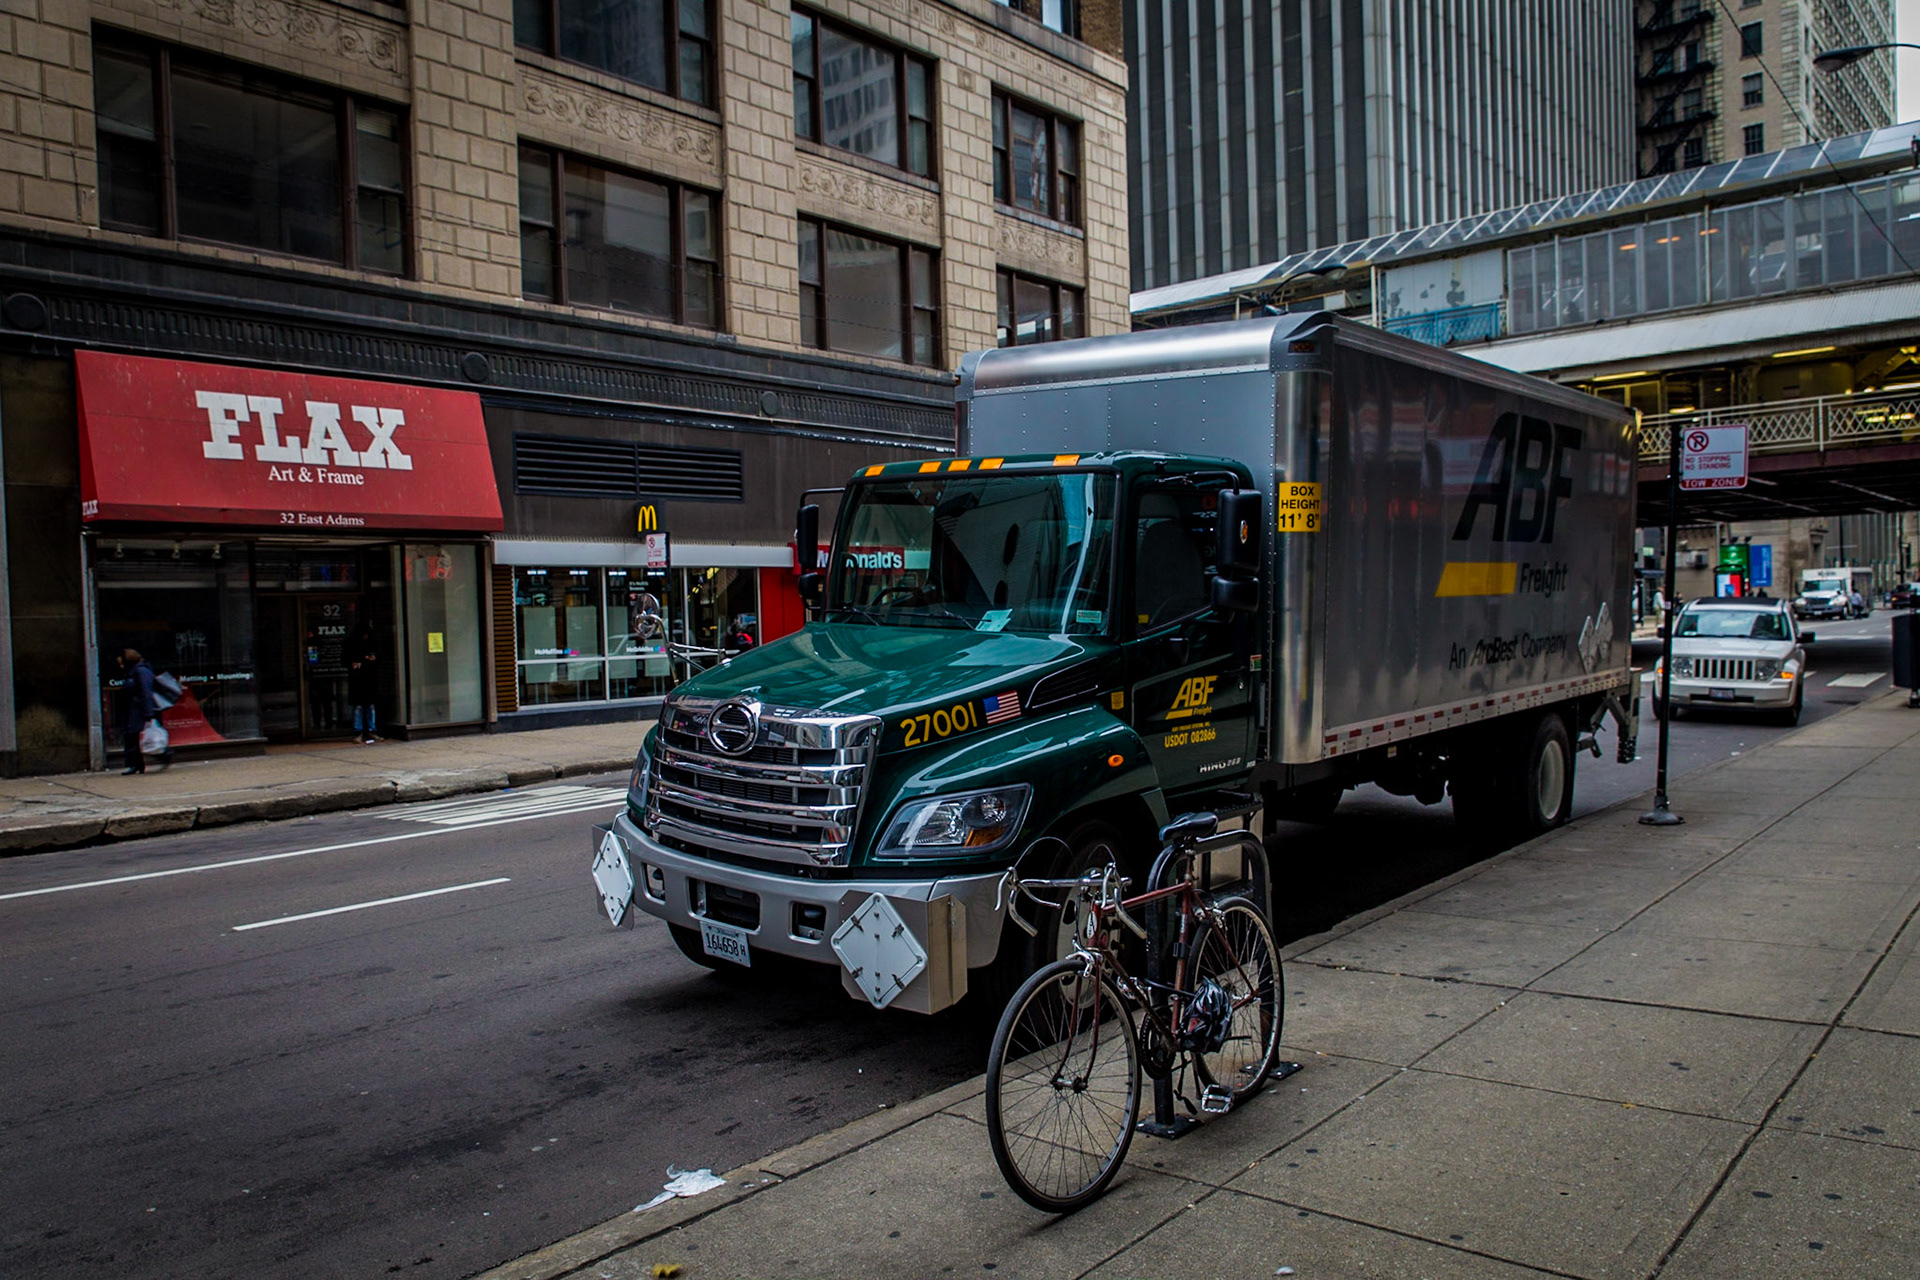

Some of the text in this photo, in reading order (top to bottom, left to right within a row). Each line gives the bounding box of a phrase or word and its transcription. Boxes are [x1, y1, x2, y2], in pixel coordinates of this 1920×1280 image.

[195, 390, 413, 470] FLAX
[1698, 455, 1731, 463] STOPPING
[268, 466, 365, 485] Art & Frame
[1451, 412, 1583, 543] ABF
[1685, 479, 1739, 488] TOW ZONE
[1290, 485, 1315, 497] BOX
[82, 499, 99, 516] FLAX
[1281, 499, 1320, 510] HEIGHT
[280, 513, 365, 526] 32 East Adams
[1519, 560, 1568, 598] Freight
[323, 605, 340, 617] 32
[318, 626, 346, 635] FLAX
[1449, 631, 1567, 671] An ArcBest Company
[1171, 675, 1218, 709] ABF
[1192, 706, 1212, 716] Freight
[900, 701, 978, 747] 27001
[1164, 728, 1216, 748] USDOT 082866
[1200, 761, 1226, 773] HINO
[706, 932, 739, 956] 164658
